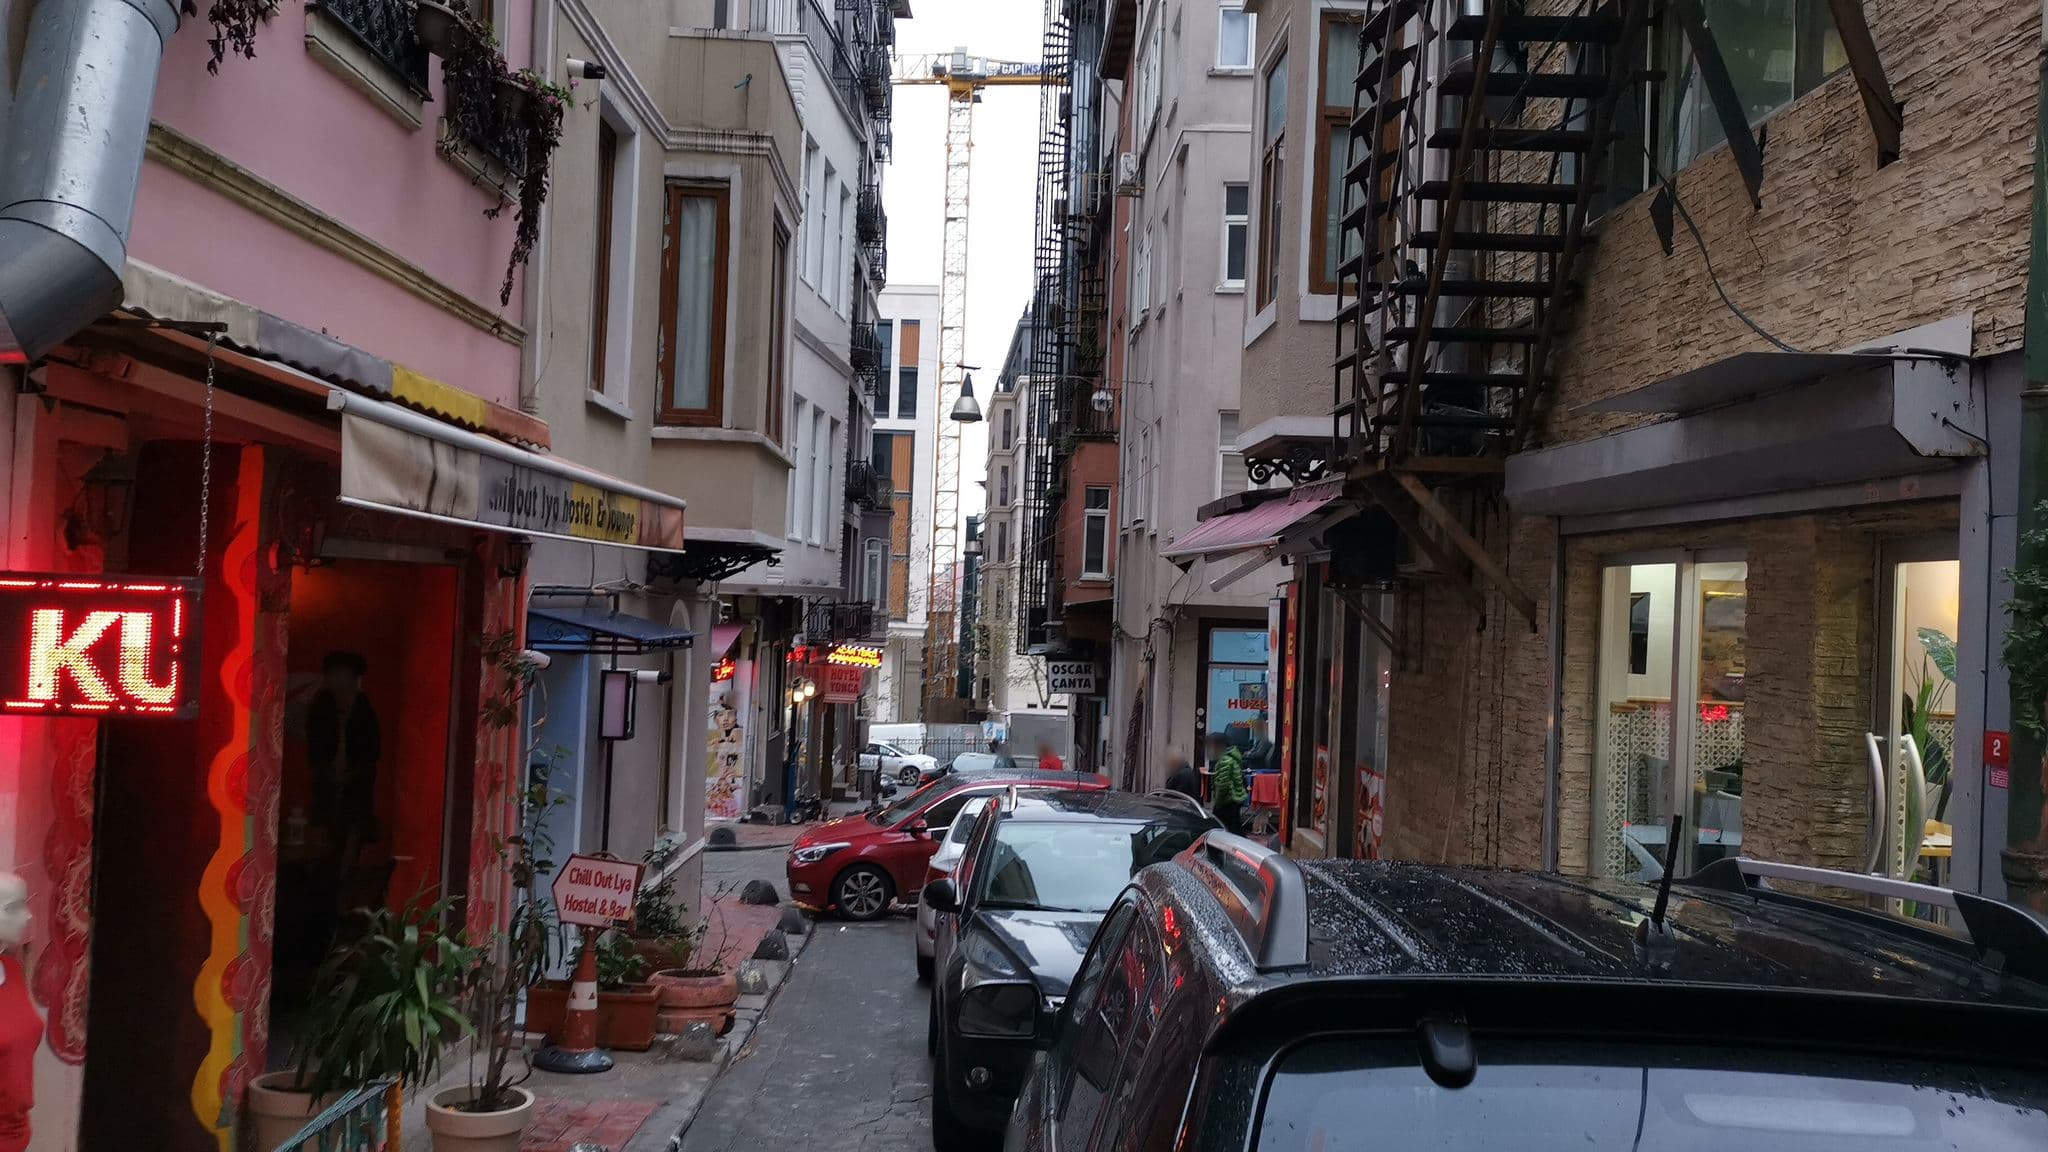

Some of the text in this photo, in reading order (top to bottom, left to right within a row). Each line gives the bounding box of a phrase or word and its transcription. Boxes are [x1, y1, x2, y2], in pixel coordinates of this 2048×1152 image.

[1001, 63, 1021, 75] GAP
[562, 490, 593, 526] hostel
[596, 498, 606, 528] &
[831, 668, 860, 681] HOTEL
[1051, 664, 1092, 675] OSCAR
[831, 681, 860, 693] YONCA
[1051, 678, 1092, 691] ÇANTA
[1993, 739, 2001, 757] 2
[569, 867, 632, 895] Chill Out Lya
[563, 894, 627, 917] Hostel & Bar
